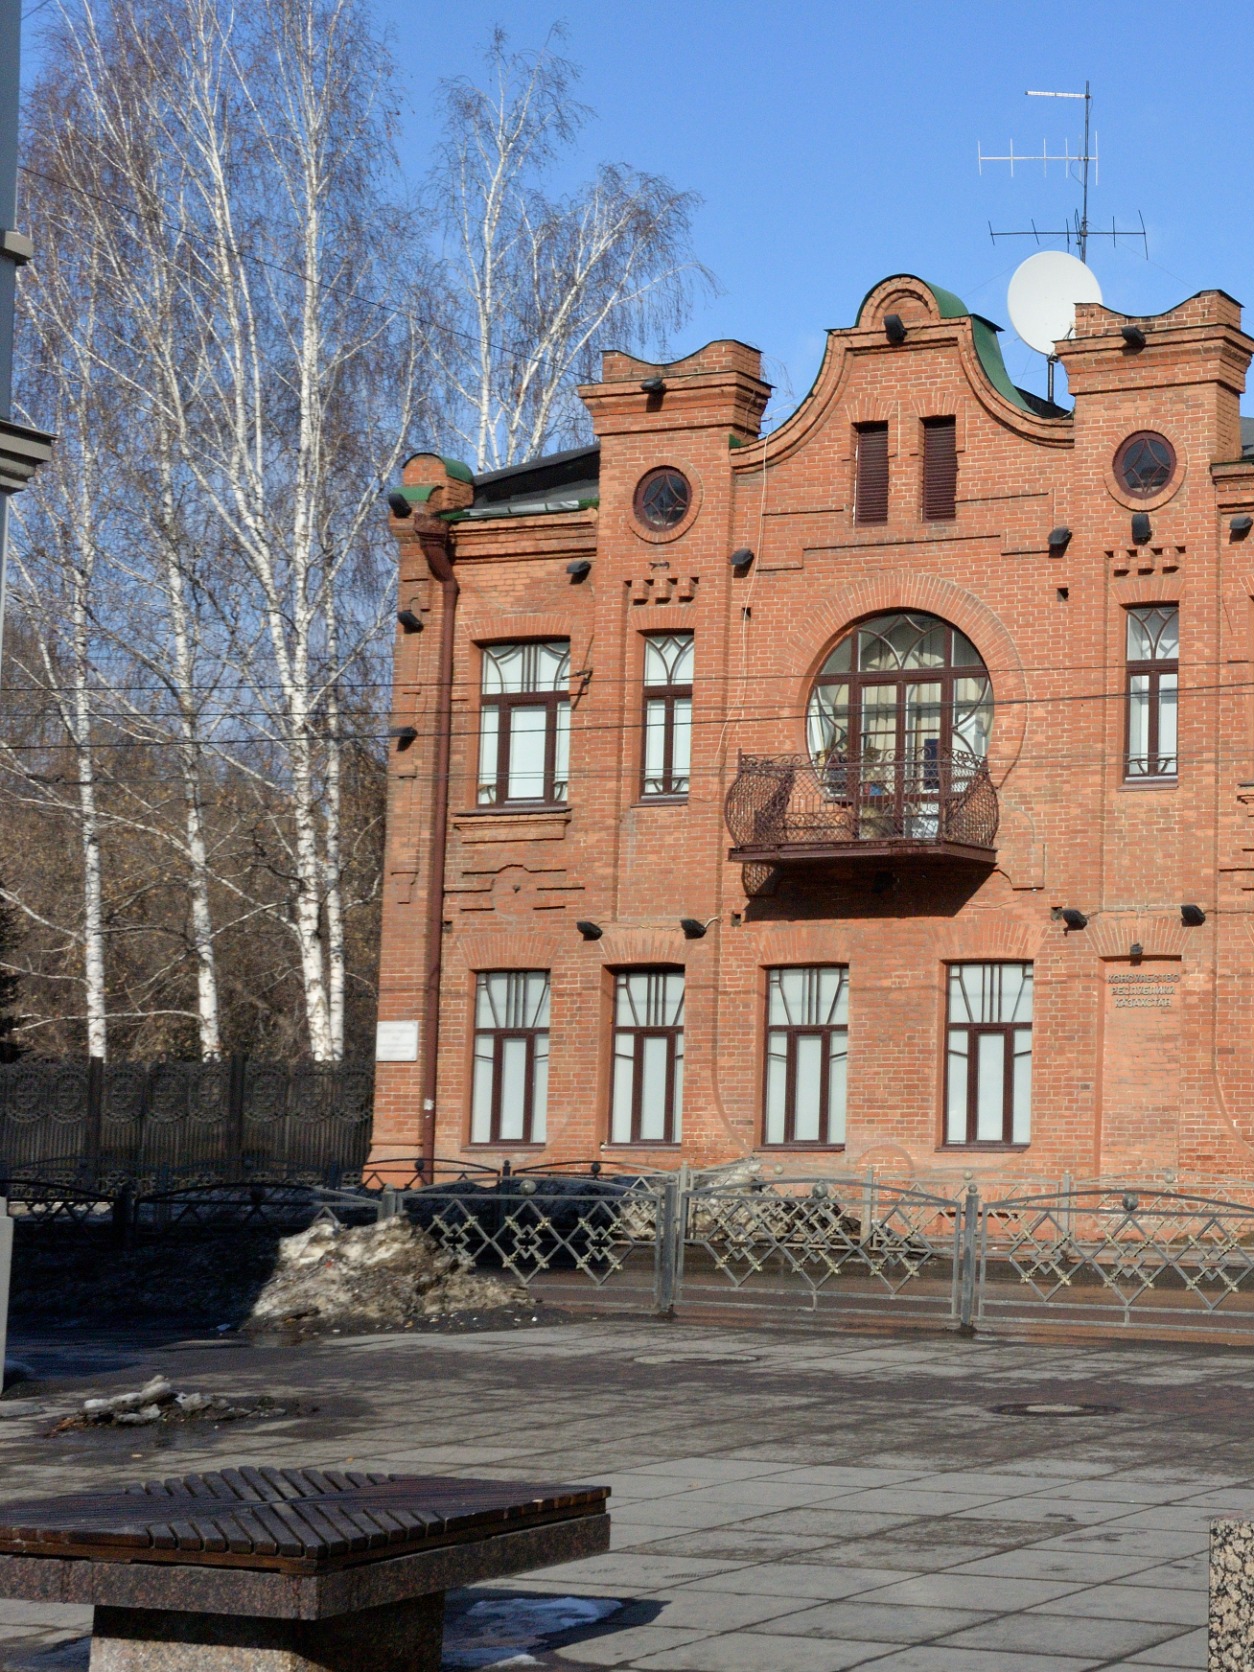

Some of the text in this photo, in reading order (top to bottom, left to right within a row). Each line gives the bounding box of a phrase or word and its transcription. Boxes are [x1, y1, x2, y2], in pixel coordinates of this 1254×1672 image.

[1108, 974, 1180, 983] КОНСУЛЬСТВО
[1112, 986, 1175, 995] РЕСПУБЛИКИ
[1116, 999, 1171, 1008] КАЗАХСТАН
